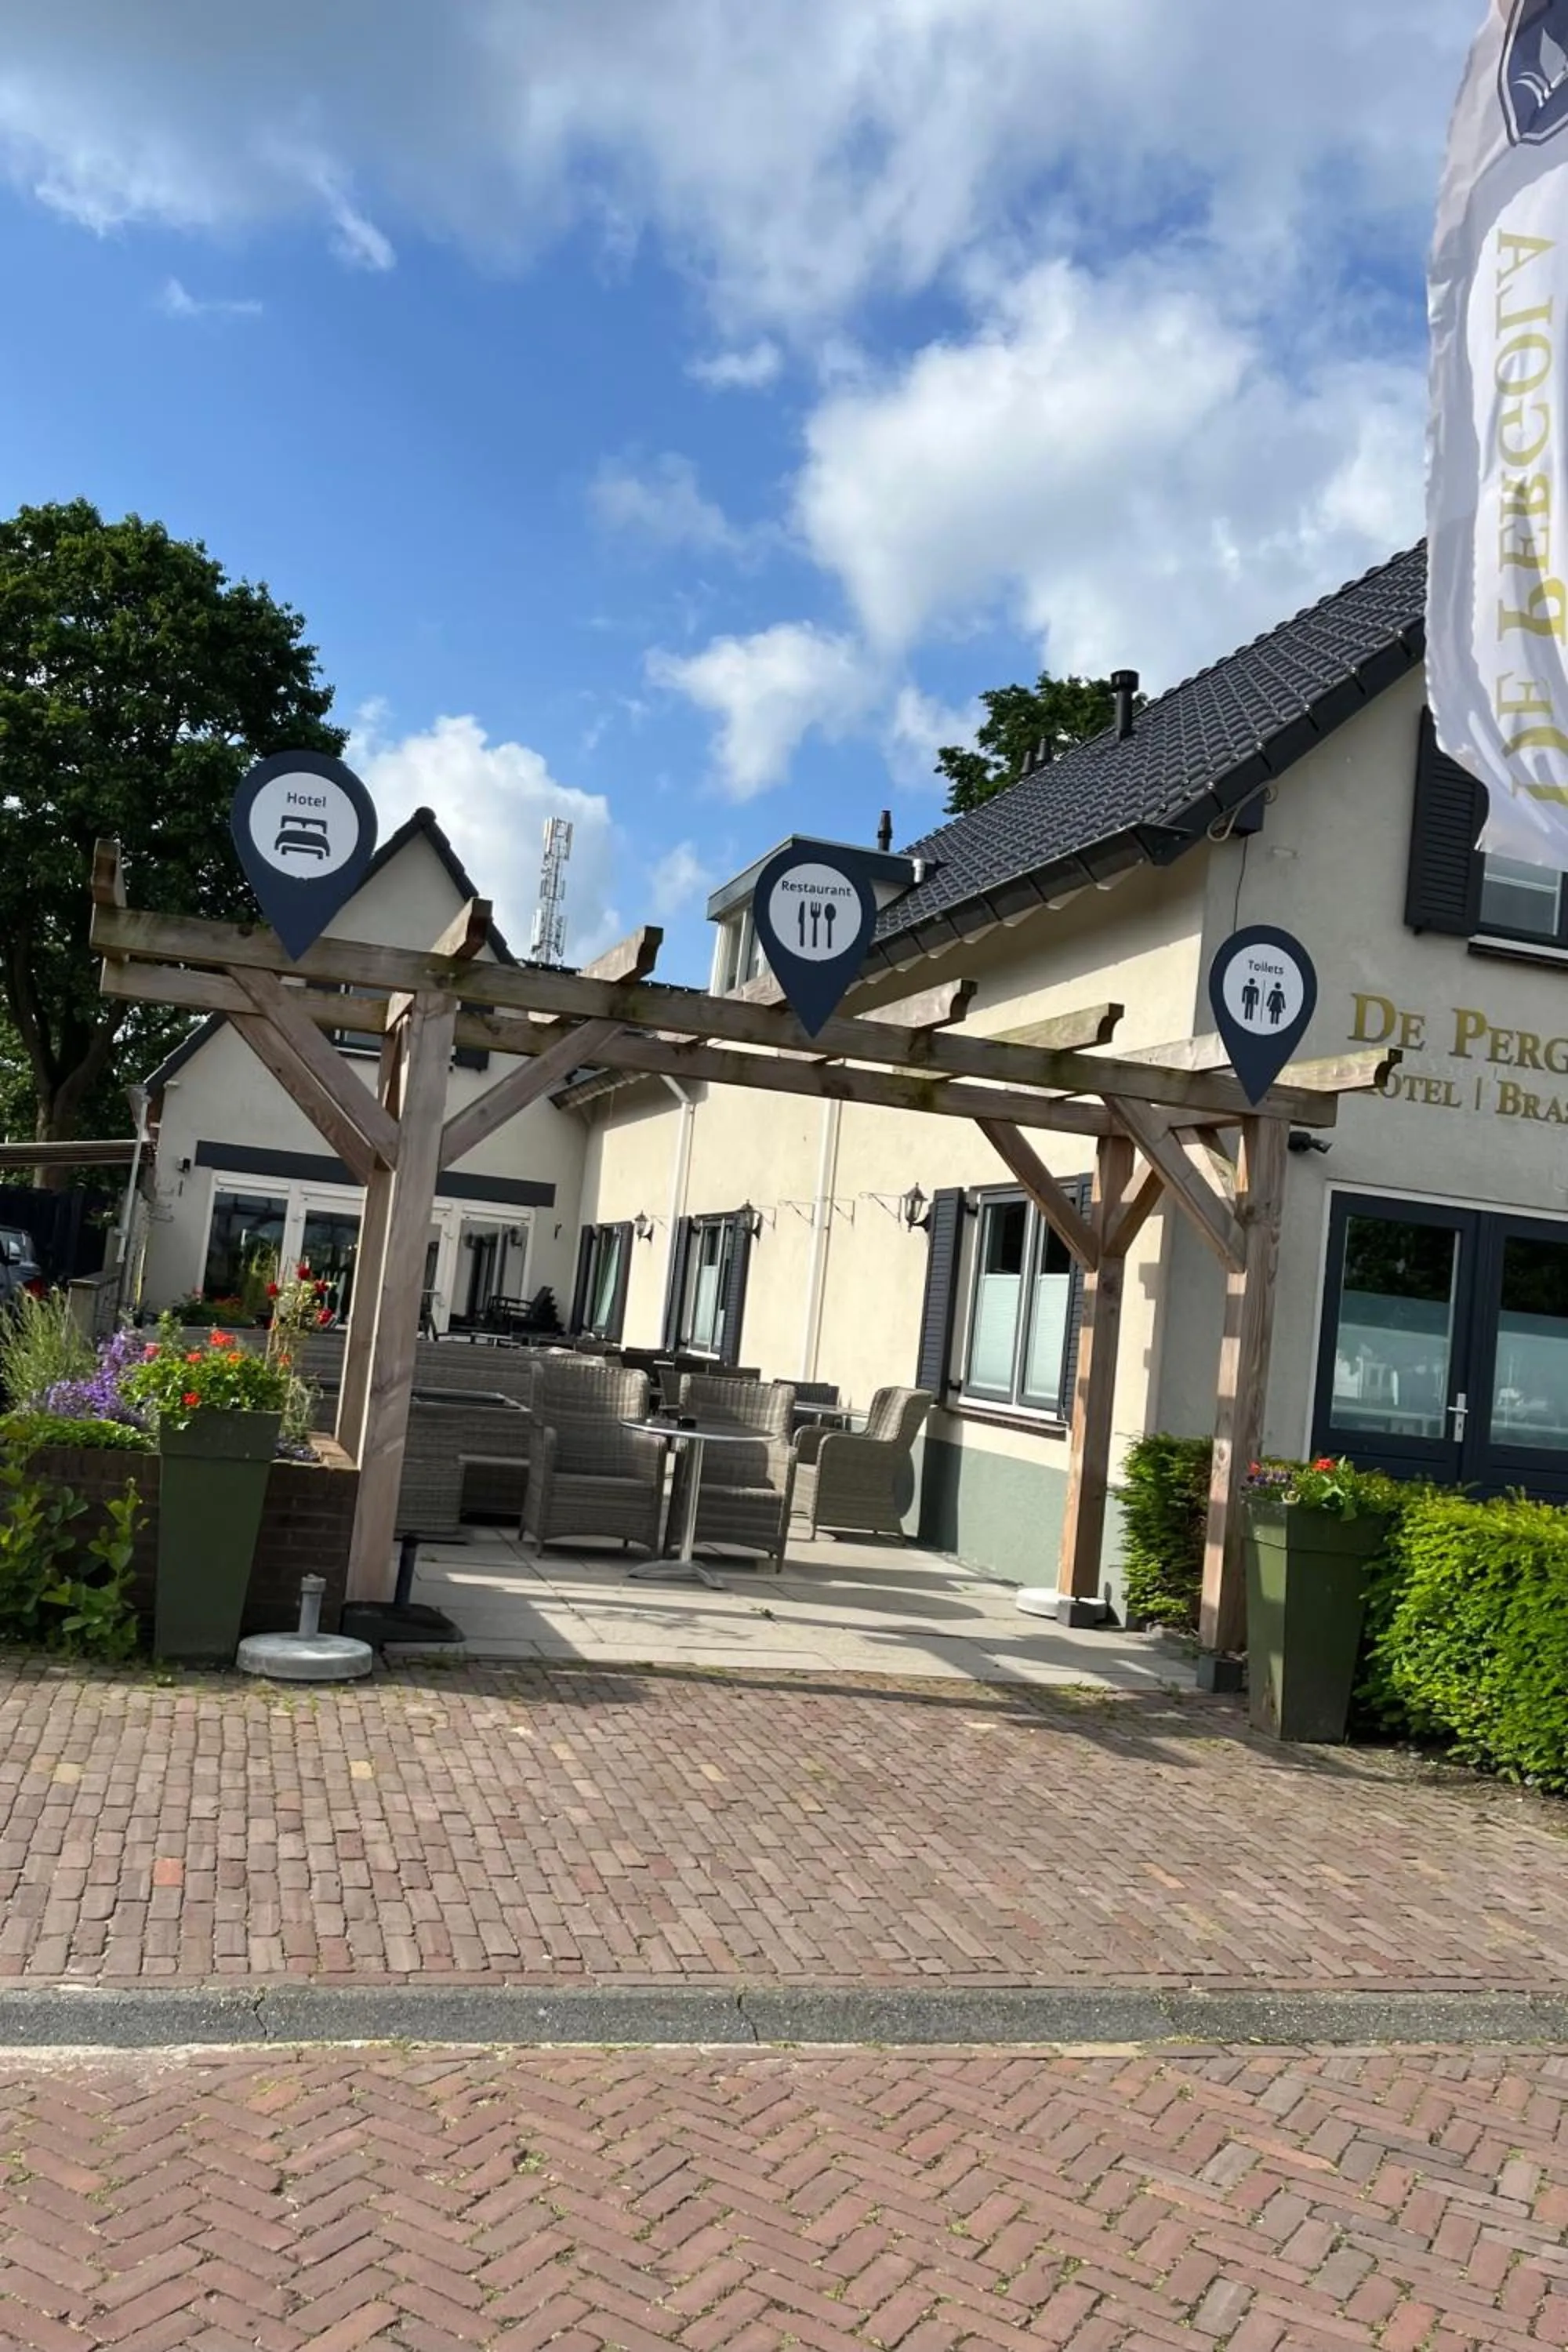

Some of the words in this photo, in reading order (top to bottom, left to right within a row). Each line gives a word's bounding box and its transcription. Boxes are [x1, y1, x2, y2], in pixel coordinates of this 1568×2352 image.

[287, 792, 326, 808] Hotel
[782, 881, 851, 897] Restaurant
[1248, 960, 1284, 975] Toilets
[1347, 992, 1426, 1051] DE
[1360, 1072, 1463, 1109] OTEL
[1495, 1080, 1568, 1125] BRA
